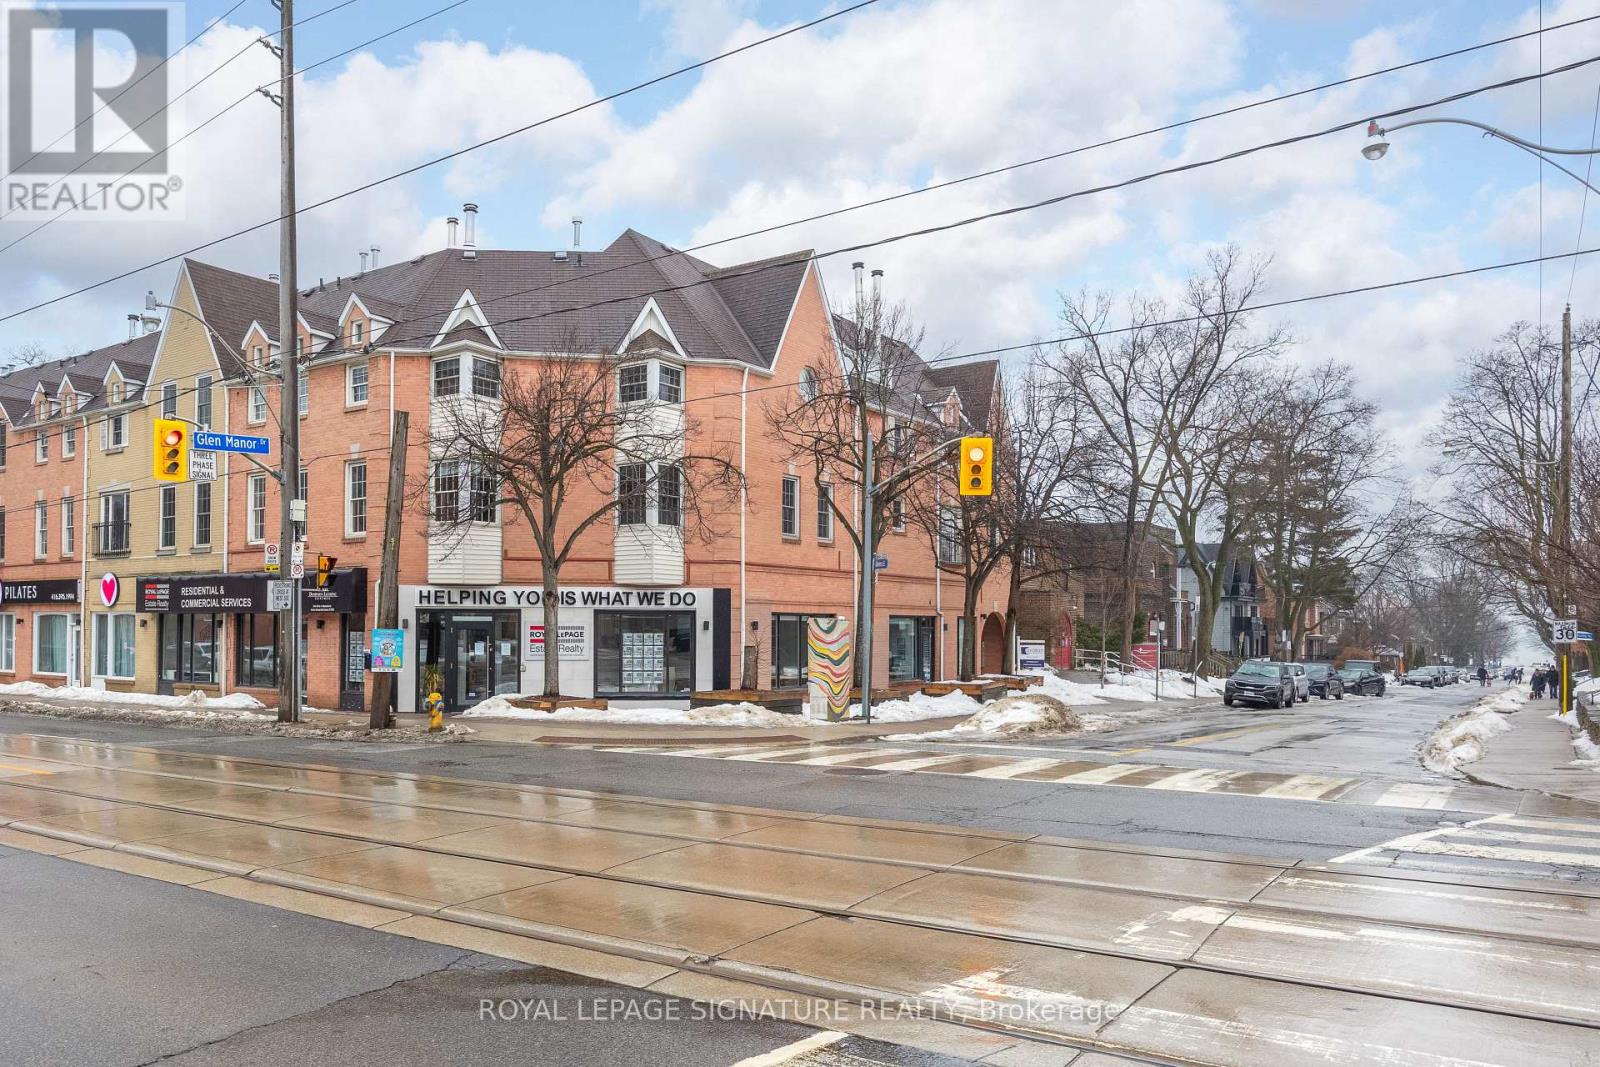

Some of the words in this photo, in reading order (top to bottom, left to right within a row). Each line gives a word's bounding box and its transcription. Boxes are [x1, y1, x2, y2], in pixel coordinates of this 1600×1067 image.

[197, 433, 221, 447] Glen
[225, 436, 257, 449] Manor
[193, 451, 213, 460] THREE
[192, 461, 214, 470] PHASE
[192, 470, 214, 480] SIGNAL
[4, 585, 37, 599] PILATES
[181, 586, 219, 596] RESIDENTIAL
[219, 585, 225, 595] &
[181, 599, 220, 608] COMMERCIAL
[221, 597, 252, 607] SERVICES
[419, 589, 507, 606] HELPING
[512, 590, 545, 606] YO
[560, 590, 577, 606] IS
[580, 591, 633, 606] WHAT
[636, 592, 665, 606] WE
[669, 592, 697, 607] DO
[1555, 630, 1575, 640] 30
[558, 643, 584, 655] Realty
